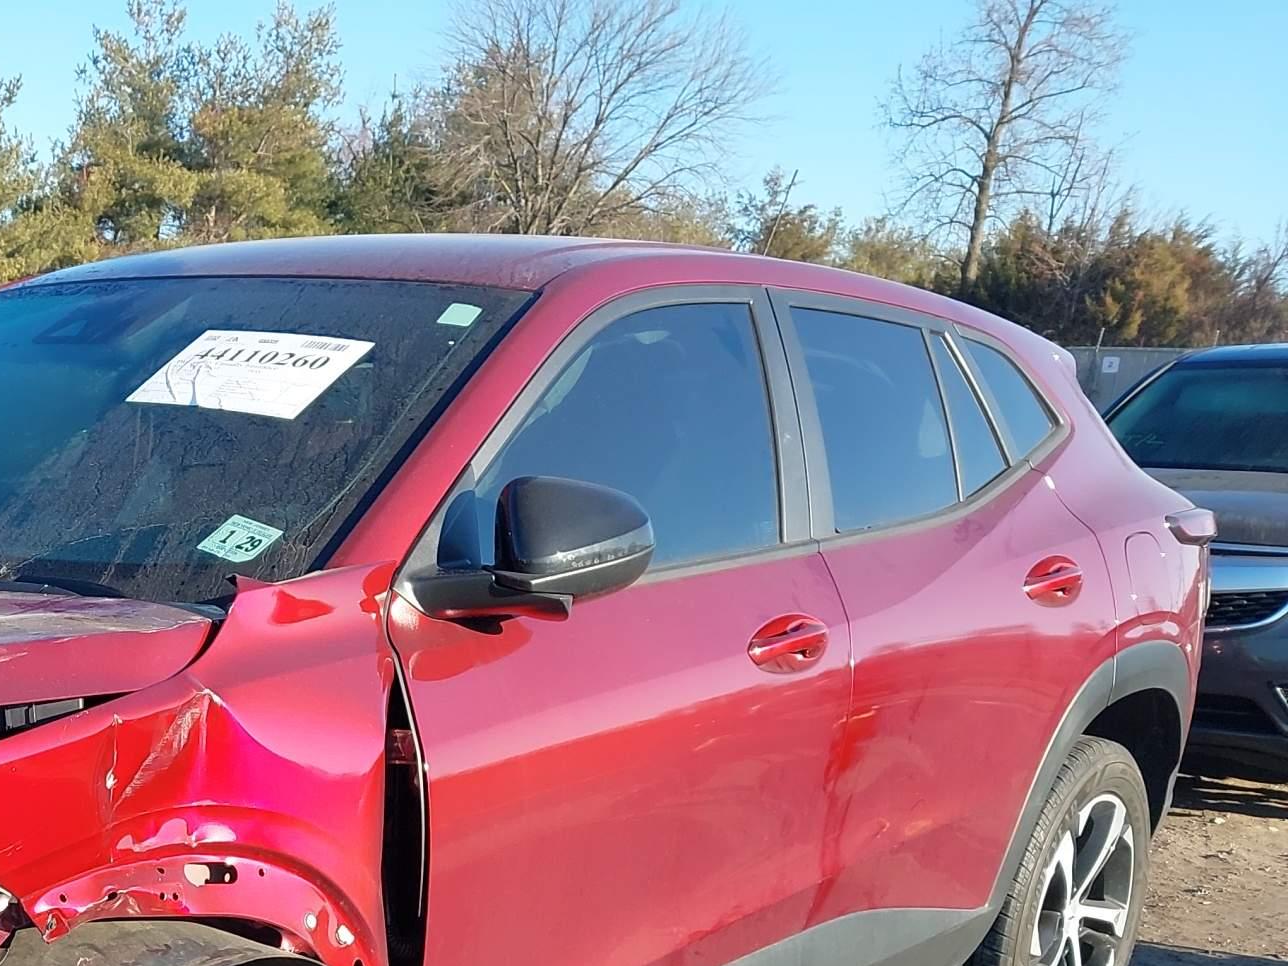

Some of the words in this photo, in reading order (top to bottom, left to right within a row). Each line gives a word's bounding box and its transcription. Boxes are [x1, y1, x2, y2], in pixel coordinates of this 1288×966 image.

[195, 347, 331, 370] 44110260
[219, 530, 236, 545] 1
[235, 535, 263, 552] 29
